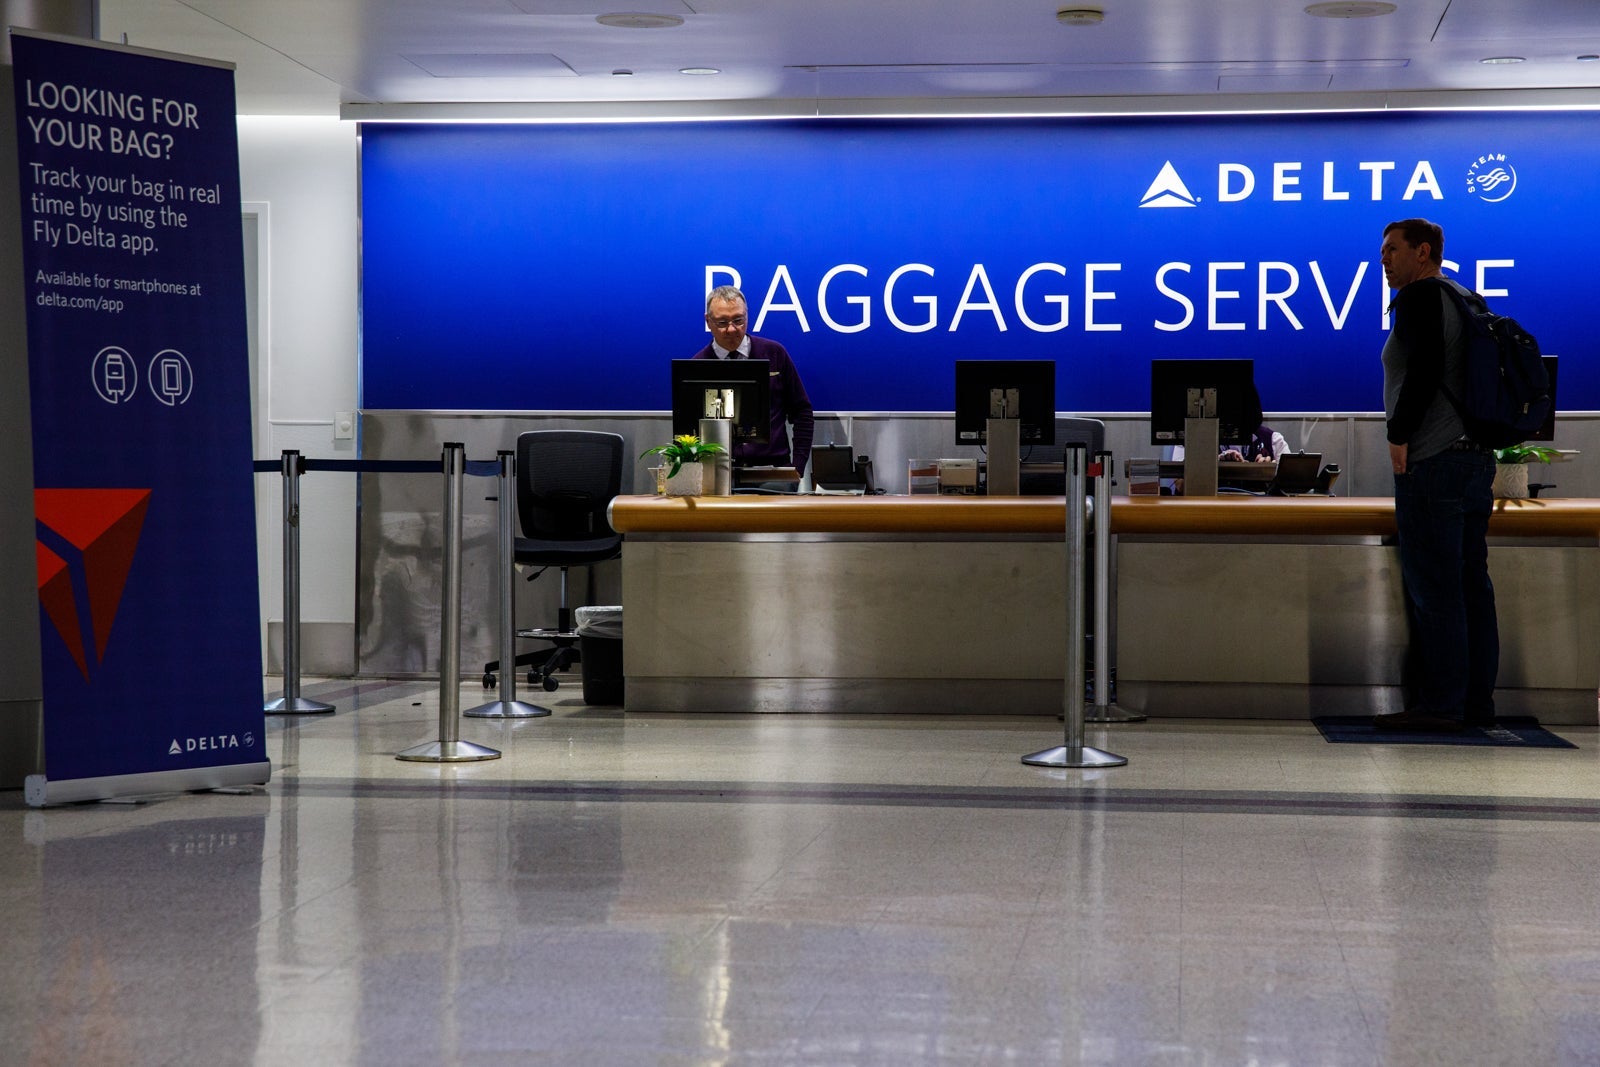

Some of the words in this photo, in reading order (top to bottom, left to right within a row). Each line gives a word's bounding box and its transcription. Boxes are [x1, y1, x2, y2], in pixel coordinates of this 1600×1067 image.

[26, 80, 145, 121] LOOKING
[153, 98, 199, 129] FOR
[28, 116, 104, 151] YOUR
[111, 127, 174, 159] BAG?
[30, 162, 81, 188] Track
[86, 175, 127, 195] your
[132, 173, 165, 202] bag
[170, 180, 184, 200] in
[190, 184, 221, 205] real
[1218, 161, 1444, 202] DELTA
[1466, 153, 1506, 194] SKYTEAM
[32, 193, 75, 216] time
[80, 196, 102, 223] by
[108, 201, 155, 228] using
[160, 206, 188, 227] the
[33, 220, 61, 248] Fly
[66, 223, 116, 248] Delta
[121, 234, 159, 256] app.
[35, 270, 91, 288] Available
[94, 273, 111, 289] for
[113, 279, 188, 295] smartphones
[190, 284, 202, 296] at
[36, 291, 124, 313] delta.com/app
[1154, 260, 1515, 332] SERVIE
[186, 734, 239, 752] DELTA
